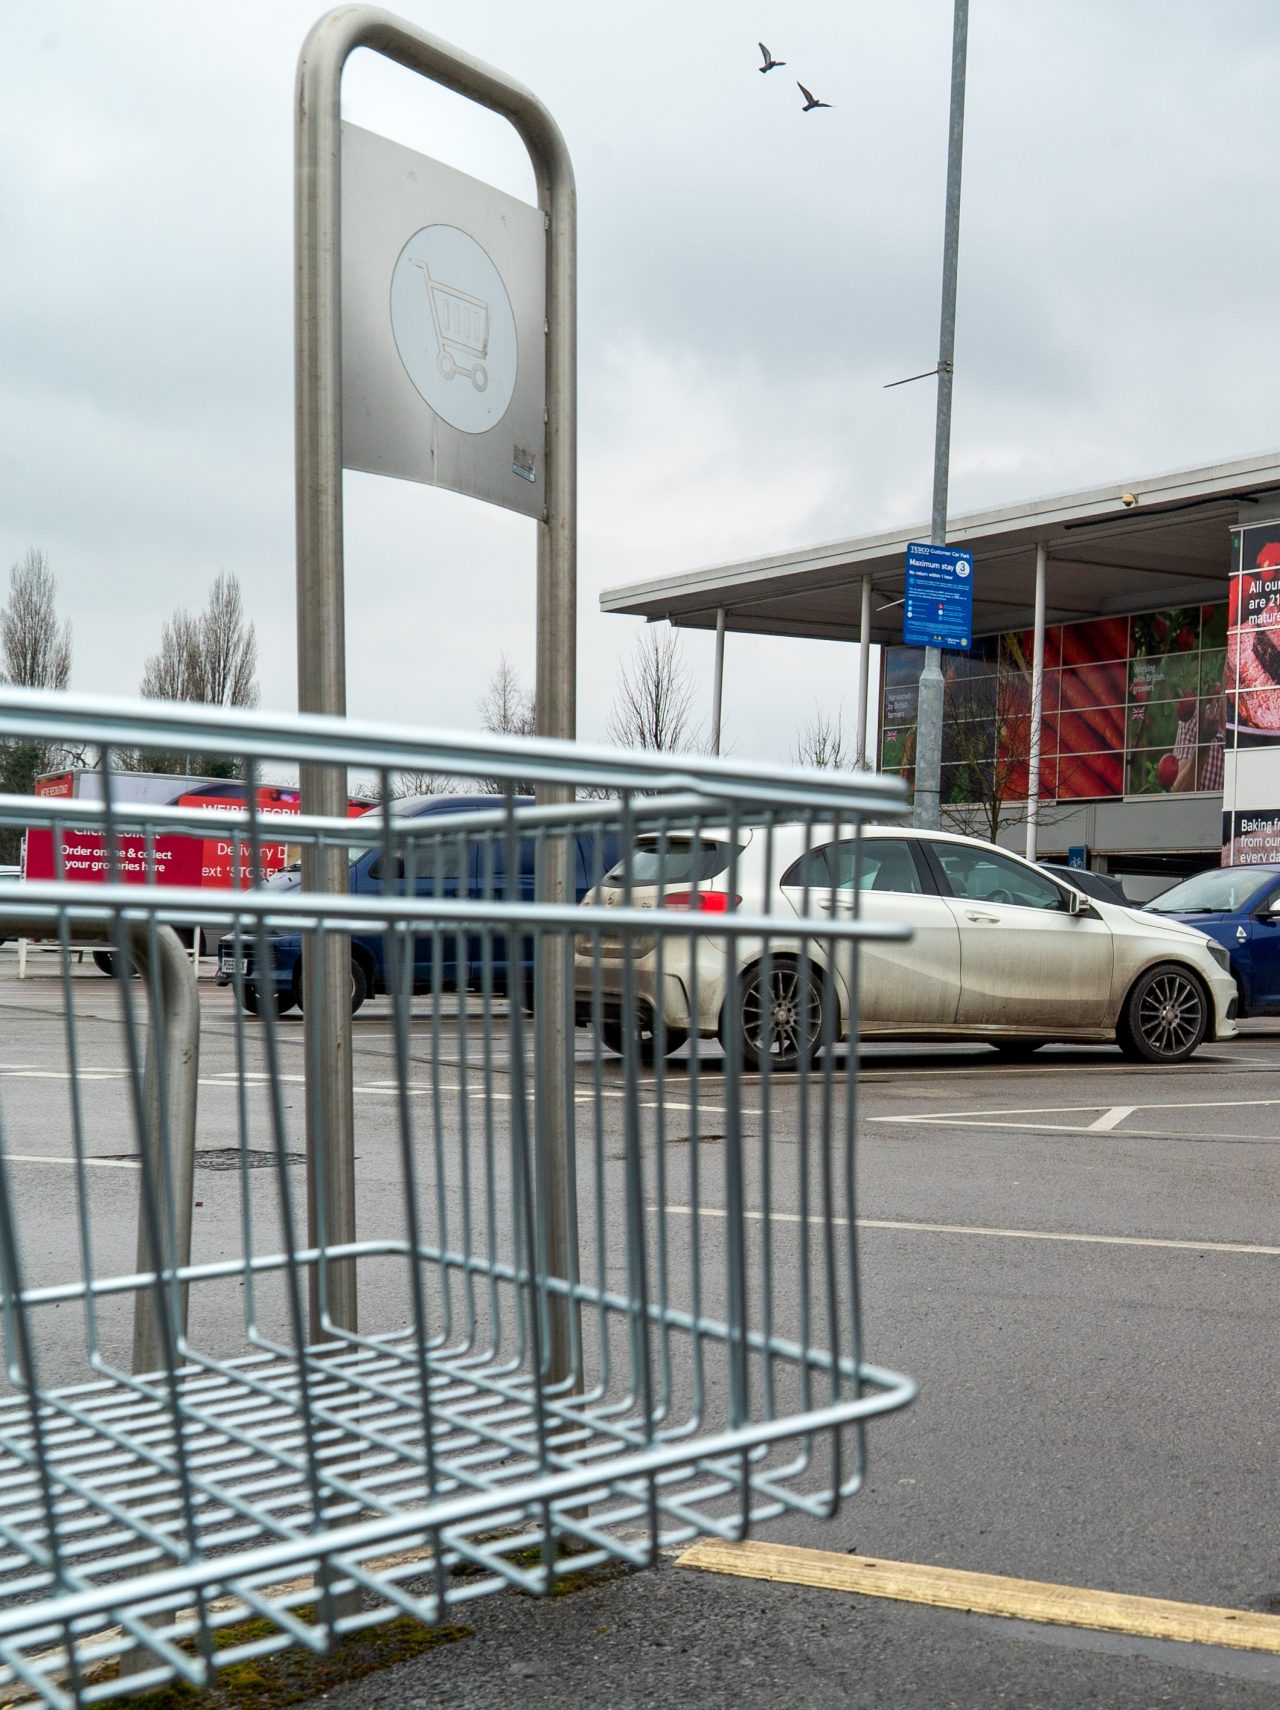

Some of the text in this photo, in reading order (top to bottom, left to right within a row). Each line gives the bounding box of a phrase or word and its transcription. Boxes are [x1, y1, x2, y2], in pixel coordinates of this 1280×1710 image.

[910, 558, 966, 572] Maximum stay 3
[1250, 580, 1262, 594] All
[1249, 598, 1266, 610] are
[1241, 818, 1272, 833] Baking
[1240, 834, 1262, 847] from
[60, 845, 172, 860] Order onlne & colect
[217, 843, 274, 860] Deivry
[1240, 853, 1267, 864] every
[64, 860, 166, 872] your groeries hre
